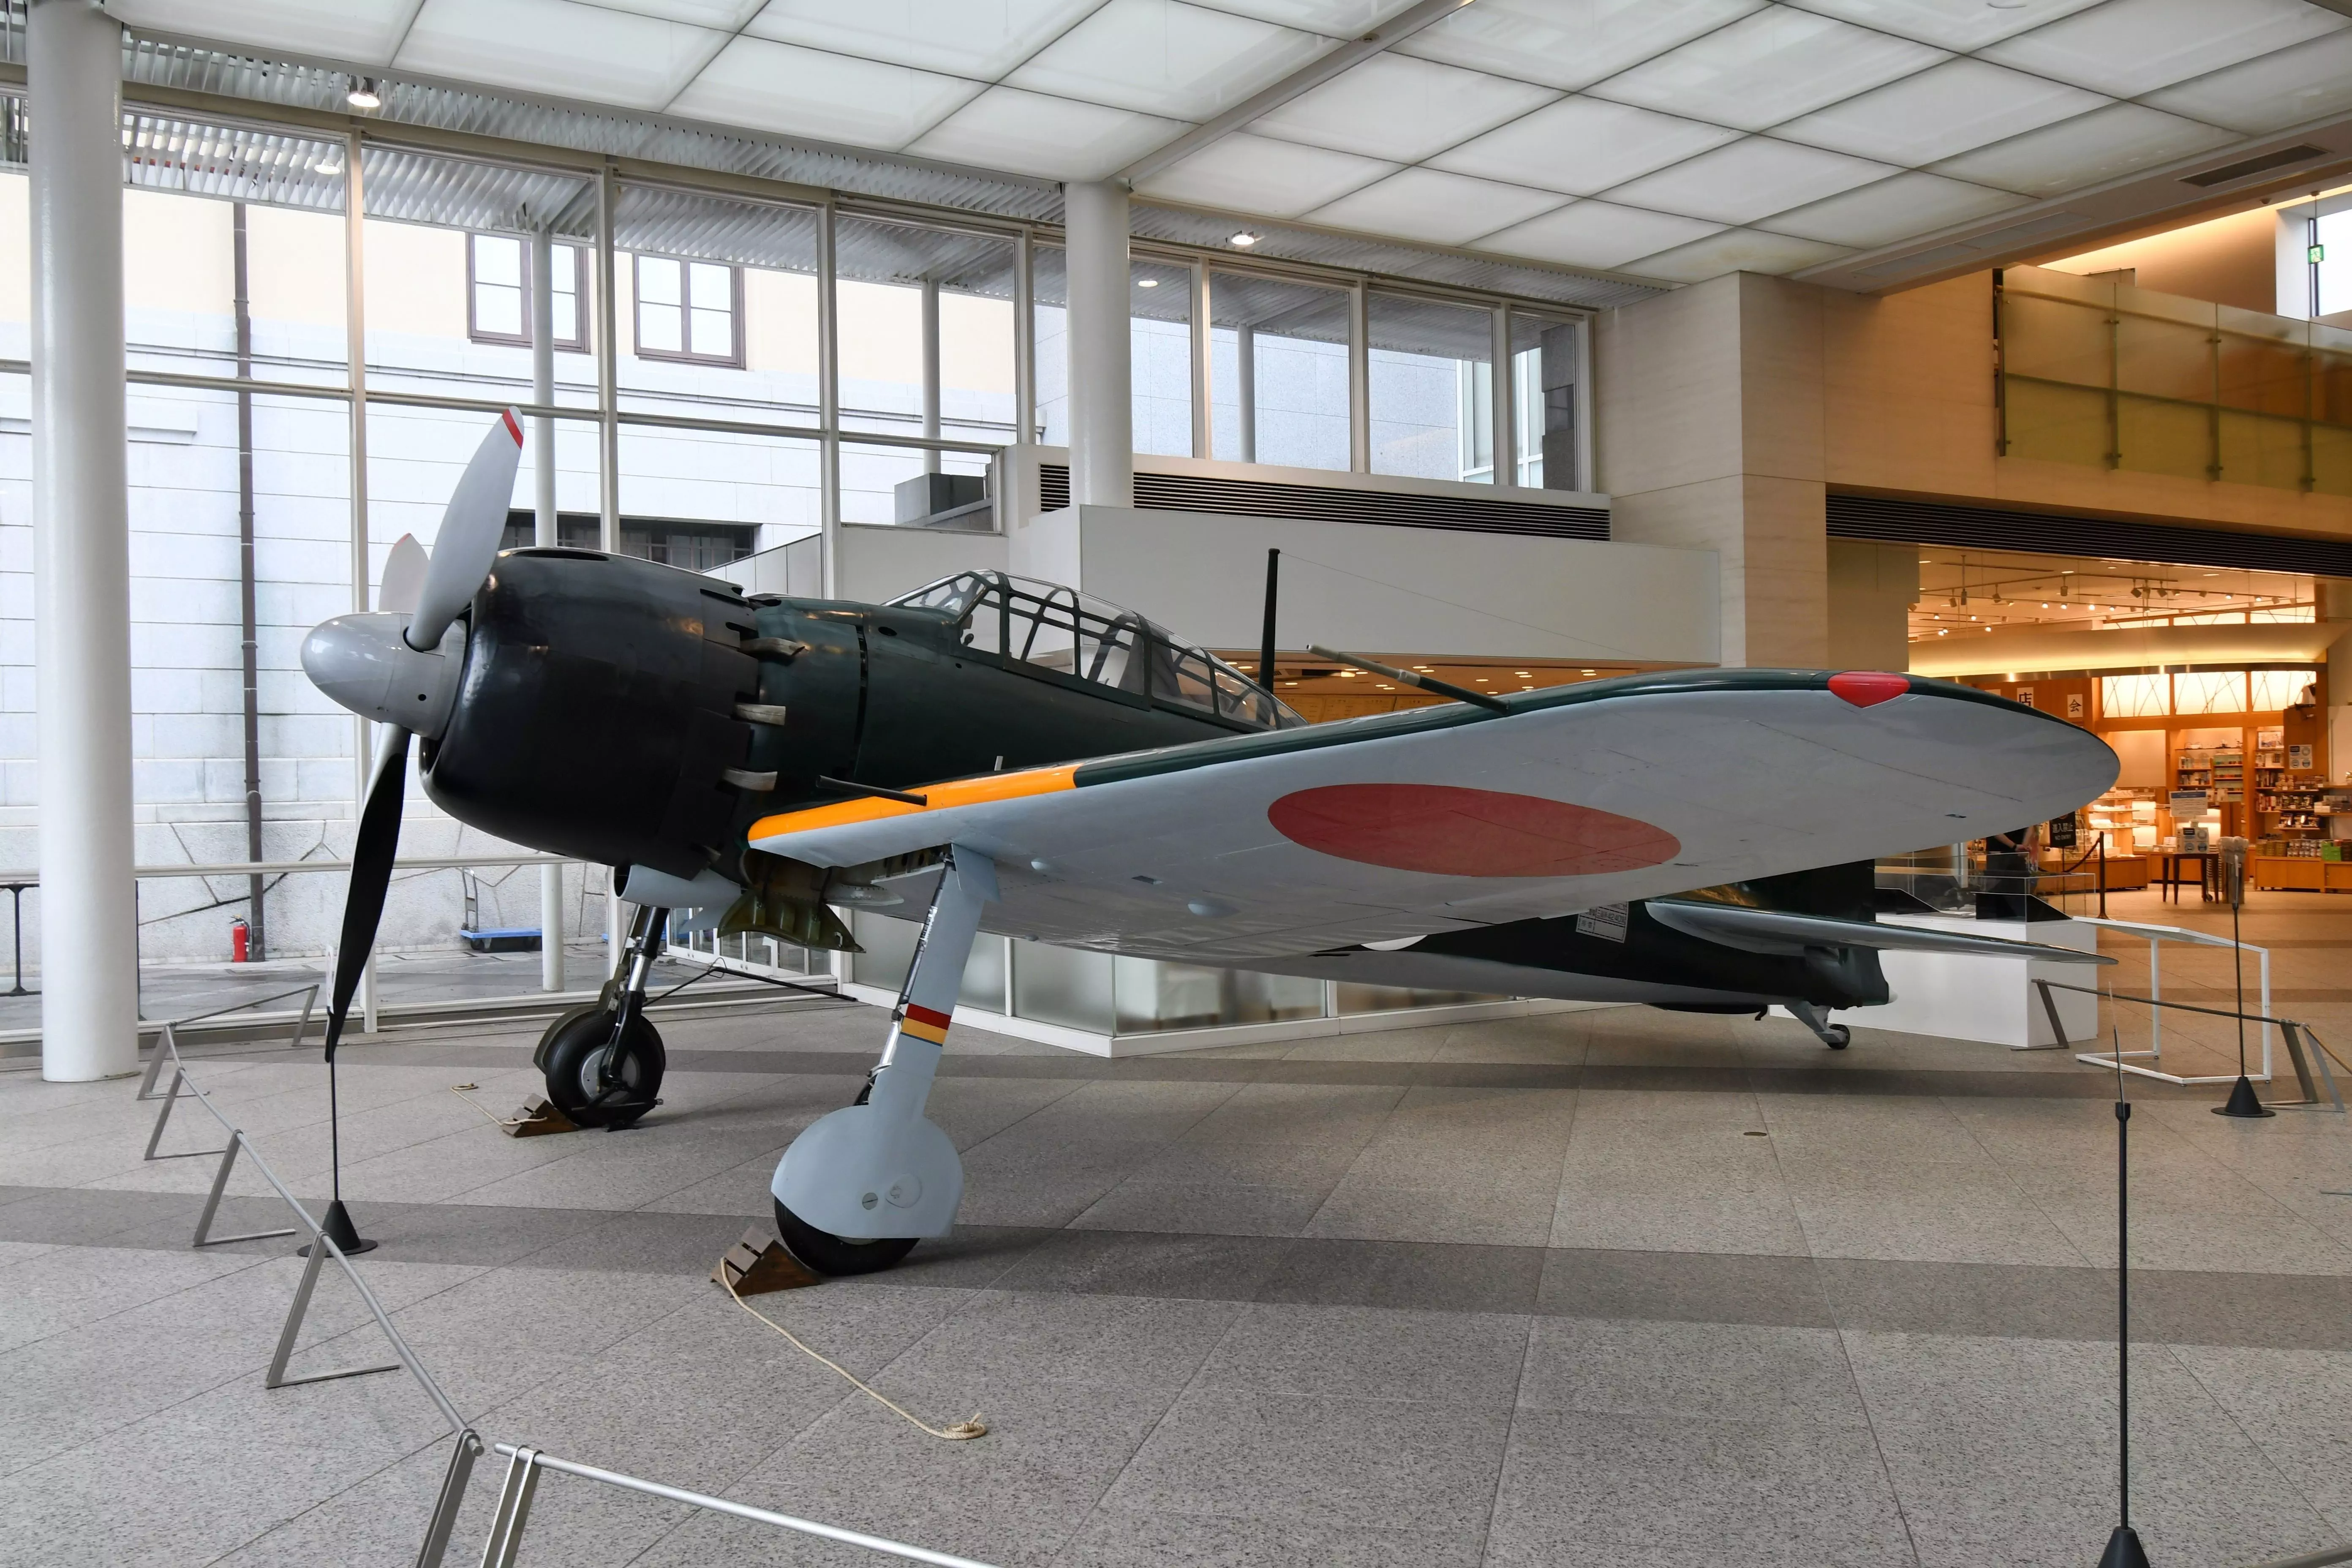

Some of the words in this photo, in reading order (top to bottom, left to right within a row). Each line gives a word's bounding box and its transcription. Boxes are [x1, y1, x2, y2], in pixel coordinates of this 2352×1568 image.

[2019, 692, 2032, 706] 店
[2069, 699, 2082, 712] 会
[2052, 822, 2073, 833] 進入禁止
